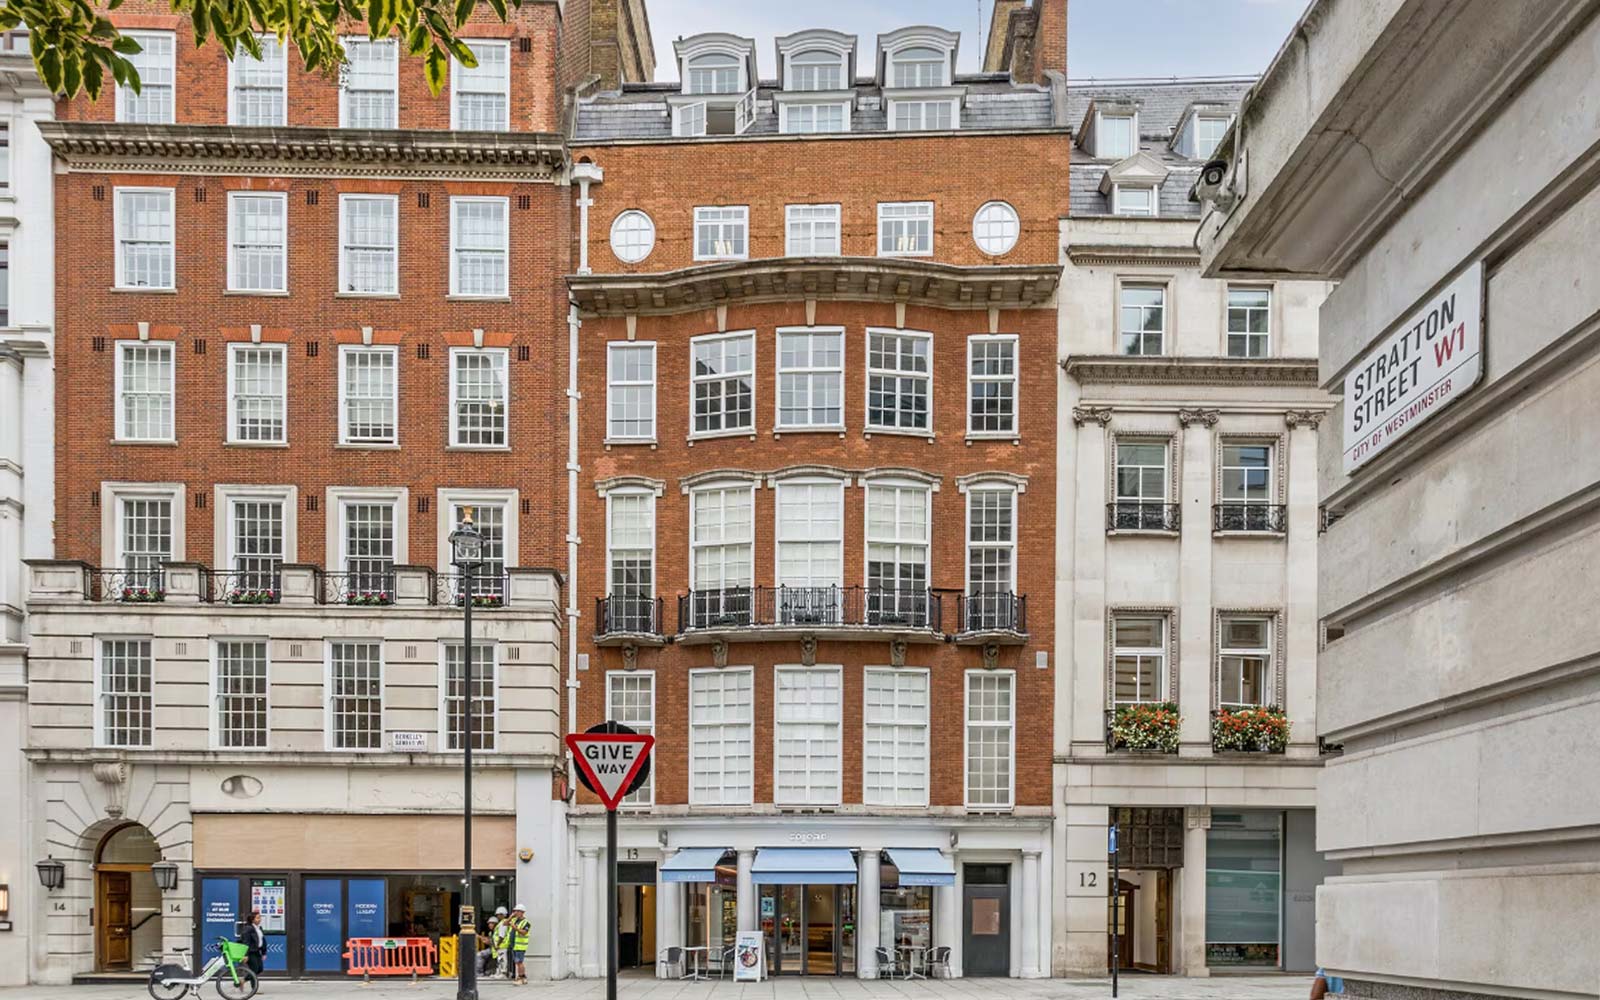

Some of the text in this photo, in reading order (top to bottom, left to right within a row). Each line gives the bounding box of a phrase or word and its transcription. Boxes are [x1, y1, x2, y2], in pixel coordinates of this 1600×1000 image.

[1354, 293, 1456, 402] STRATTON
[1353, 321, 1465, 433] STREET W1
[1353, 379, 1453, 461] CITY OF WESTMINSTER
[585, 744, 634, 760] GIVE
[597, 764, 628, 775] WAY
[626, 848, 639, 860] 13
[1080, 871, 1097, 888] 12
[53, 902, 66, 912] 14
[170, 903, 181, 913] 14
